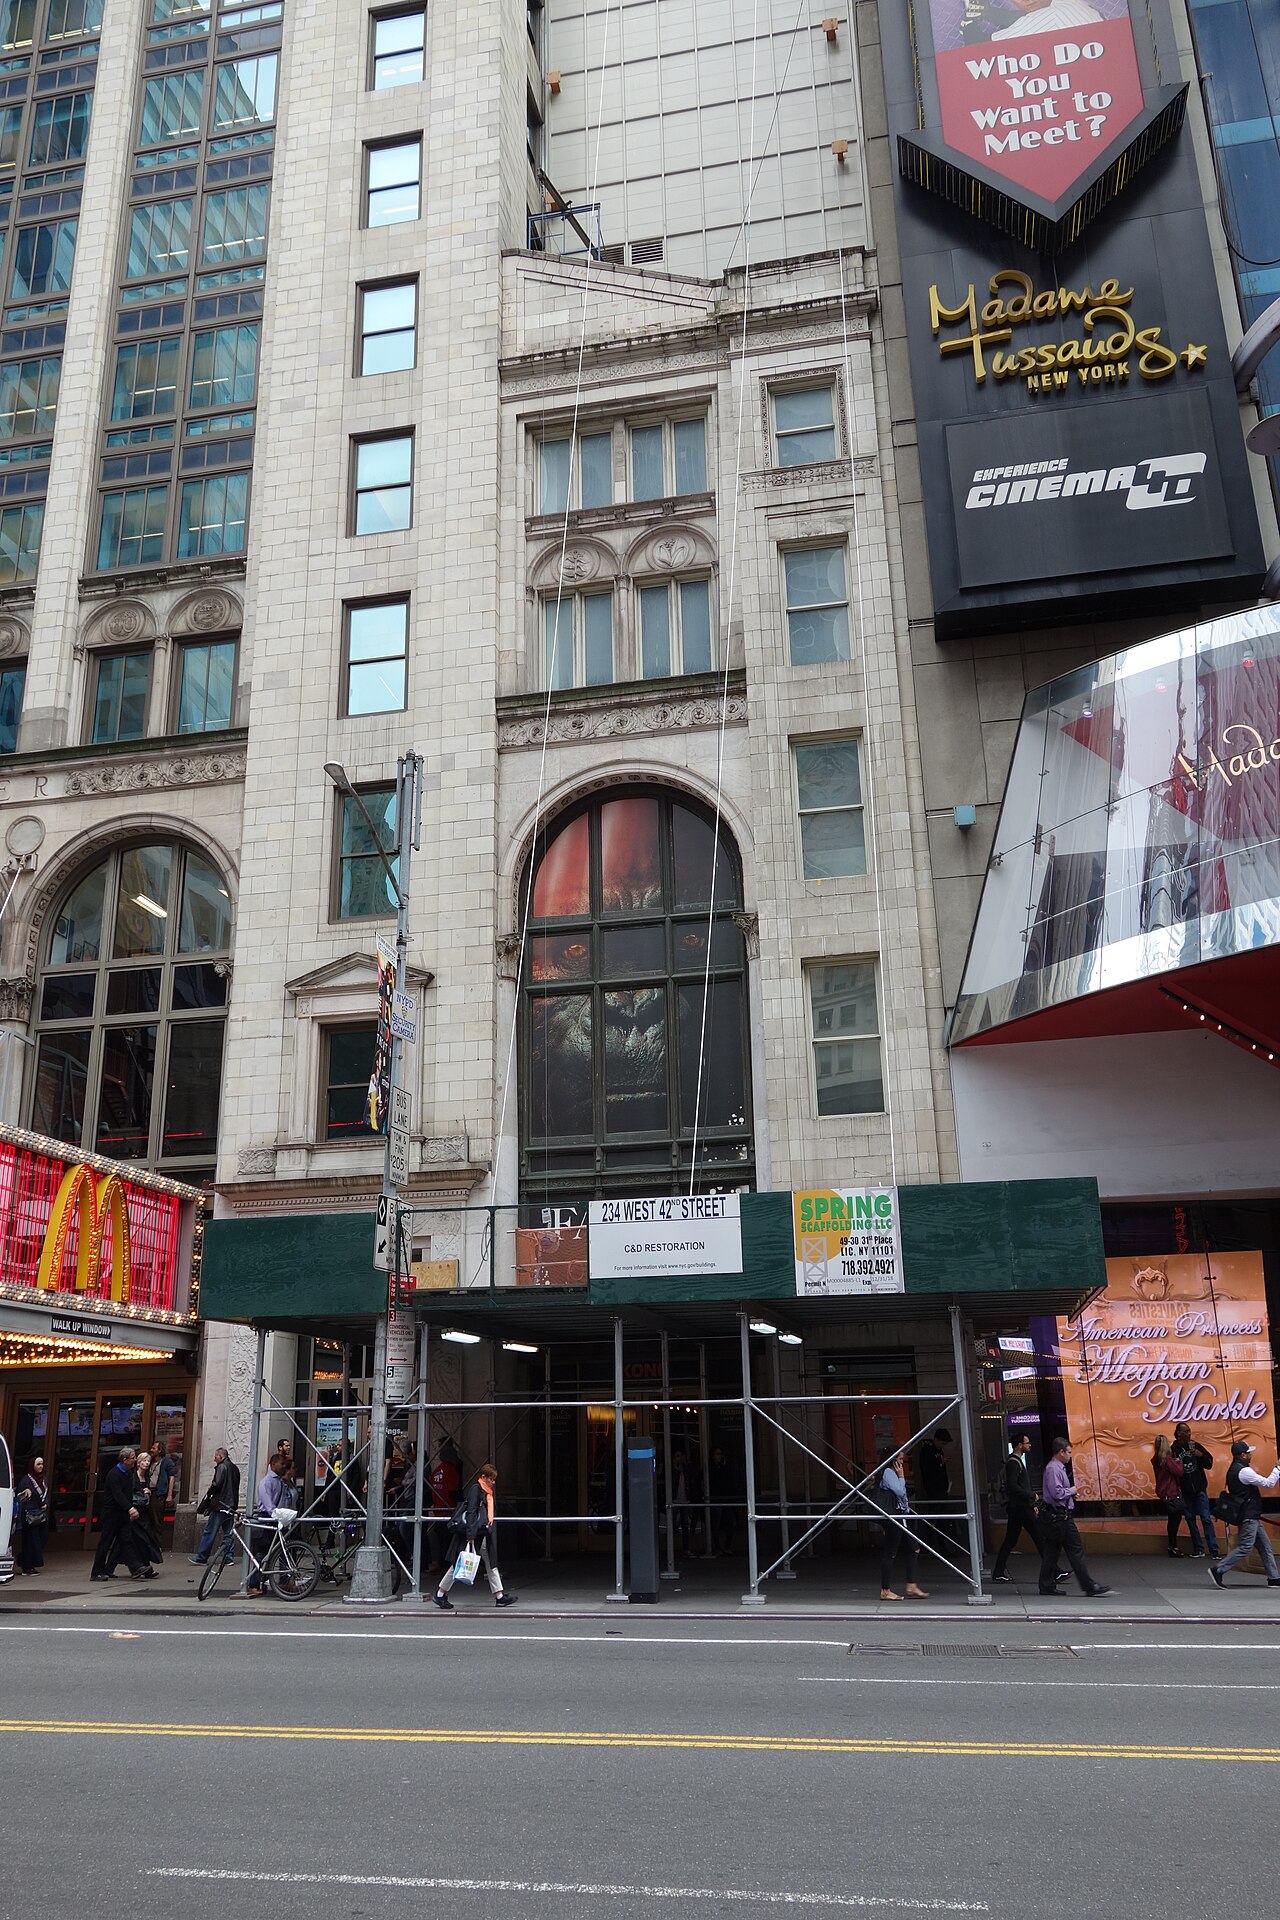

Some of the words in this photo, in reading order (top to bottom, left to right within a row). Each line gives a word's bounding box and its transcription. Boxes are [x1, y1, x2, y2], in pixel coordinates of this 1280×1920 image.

[965, 53, 1041, 80] Who
[1053, 41, 1104, 65] Do
[1005, 73, 1071, 99] You
[970, 97, 1060, 130] Want
[1072, 91, 1112, 113] to
[929, 269, 1135, 334] Madame
[940, 306, 1177, 383] Tussauds
[1027, 370, 1069, 394] NEW
[1078, 361, 1130, 386] YORK
[973, 458, 1069, 482] EXPERIENCE
[396, 993, 414, 1009] NYPD
[392, 1023, 414, 1040] CAMERA
[396, 1093, 407, 1110] BUS
[394, 1111, 408, 1128] LANE
[602, 1202, 620, 1222] 234
[624, 1200, 656, 1221] WEST
[681, 1196, 726, 1218] STREET
[801, 1195, 892, 1221] SPRING
[801, 1219, 872, 1232] SCAFFOLDING
[875, 1218, 892, 1230] LLC
[624, 1244, 643, 1253] C&D
[644, 1241, 705, 1252] RESTORATION
[840, 1236, 859, 1246] 49-30
[874, 1235, 893, 1244] Place
[858, 1246, 869, 1256] NY
[872, 1245, 894, 1256] 11101
[841, 1258, 895, 1276] 718.392.4921
[52, 1318, 71, 1331] WALK
[72, 1321, 81, 1333] UP
[82, 1323, 108, 1336] WINDOW
[1058, 1317, 1169, 1342] American
[1174, 1311, 1262, 1339] Princess
[1075, 1344, 1212, 1398] Meghan
[1142, 1382, 1267, 1423] Markle
